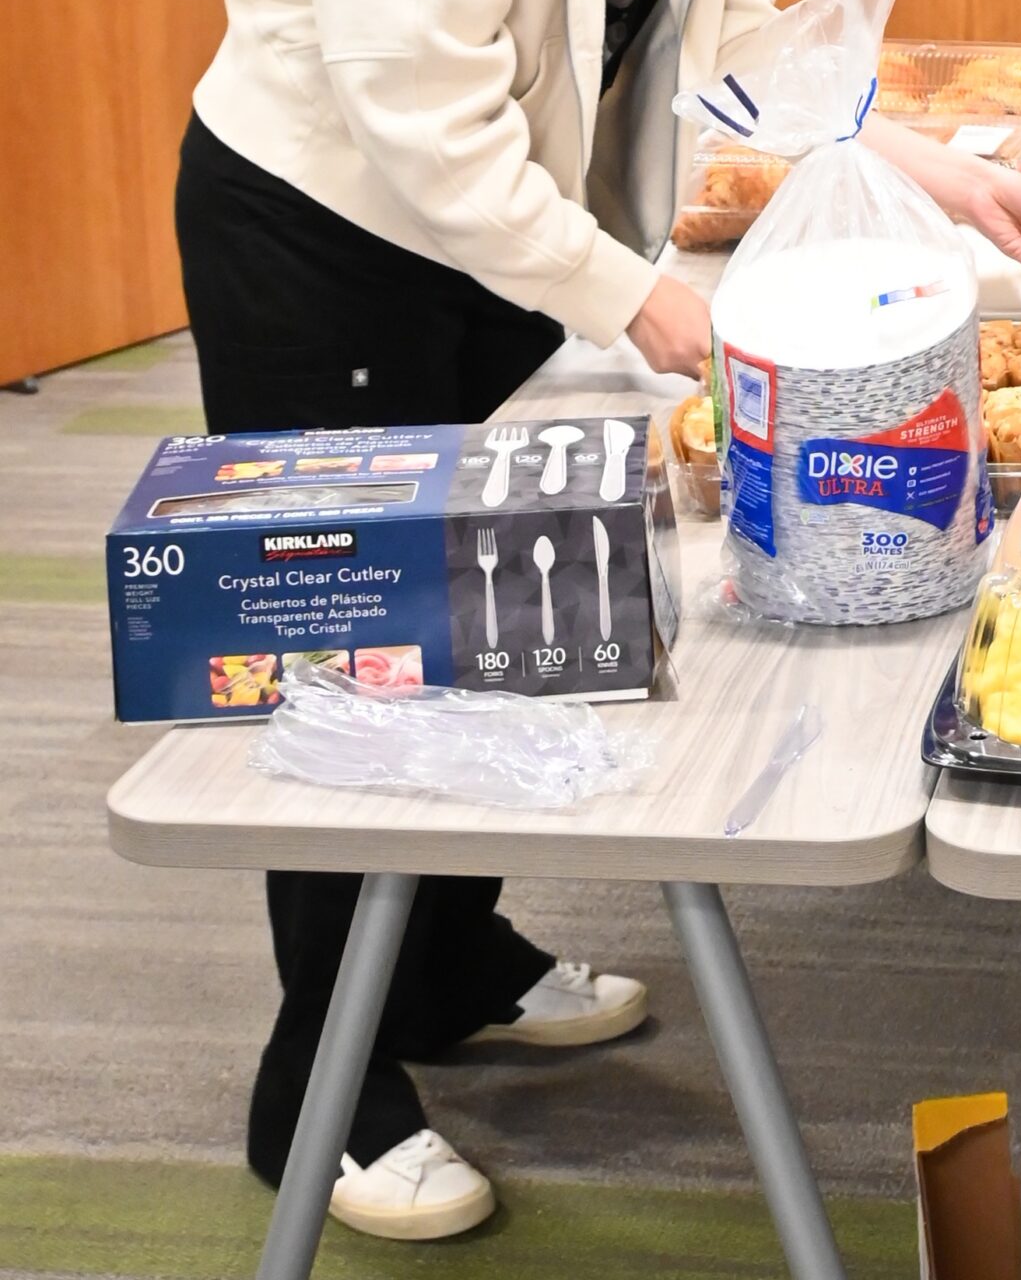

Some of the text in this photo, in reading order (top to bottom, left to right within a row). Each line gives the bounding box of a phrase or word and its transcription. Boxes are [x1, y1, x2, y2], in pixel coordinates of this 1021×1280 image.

[900, 418, 958, 440] STRENGTH
[515, 454, 542, 464] 120
[574, 453, 598, 462] 60
[818, 477, 884, 497] ULTRA
[264, 533, 353, 551] KIRKLAND
[862, 532, 908, 547] 300
[123, 544, 185, 577] 360
[863, 547, 903, 556] PLATES
[218, 566, 402, 592] Crystal Clear Cutlery
[241, 593, 382, 611] Cubiertos de Plástico
[238, 605, 387, 625] Transparente Acabado
[275, 622, 352, 638] Tipo Cristal
[475, 652, 510, 671] 180
[532, 647, 566, 667] 120
[594, 643, 620, 662] 60
